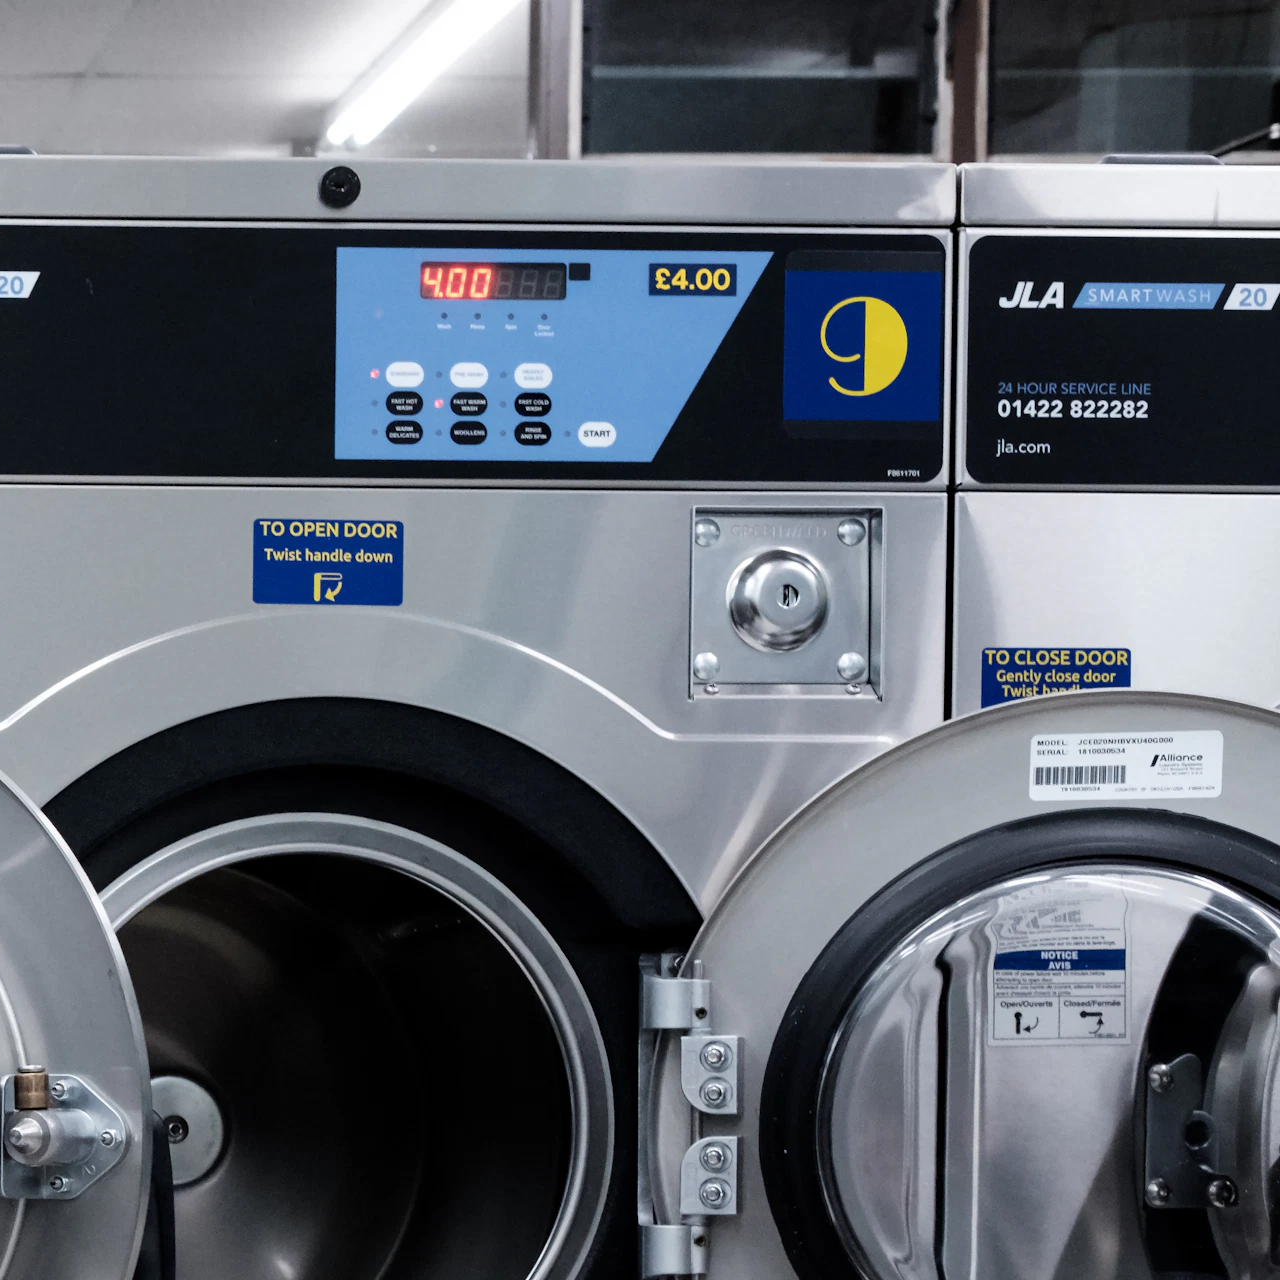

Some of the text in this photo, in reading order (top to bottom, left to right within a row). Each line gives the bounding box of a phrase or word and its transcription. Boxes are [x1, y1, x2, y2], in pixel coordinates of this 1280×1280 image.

[423, 266, 492, 298] 4.00
[655, 268, 731, 291] £4.00
[998, 281, 1065, 308] JLA
[1239, 287, 1268, 307] 20
[820, 296, 908, 396] 9
[998, 382, 1151, 395] 24 HOUR SERVICE LINE
[997, 399, 1149, 419] 01422 822282
[583, 430, 611, 438] START
[996, 439, 1051, 457] jla.com
[260, 521, 398, 539] TO OPEN DOOR
[264, 548, 393, 563] Twist handle down
[985, 649, 1128, 666] TO CLOSE DOOR
[996, 669, 1117, 684] Gently close door
[1002, 684, 1039, 697] Twist
[1159, 754, 1203, 762] Alliance
[1041, 950, 1078, 960] NOTICE
[1048, 961, 1071, 970] AVIS
